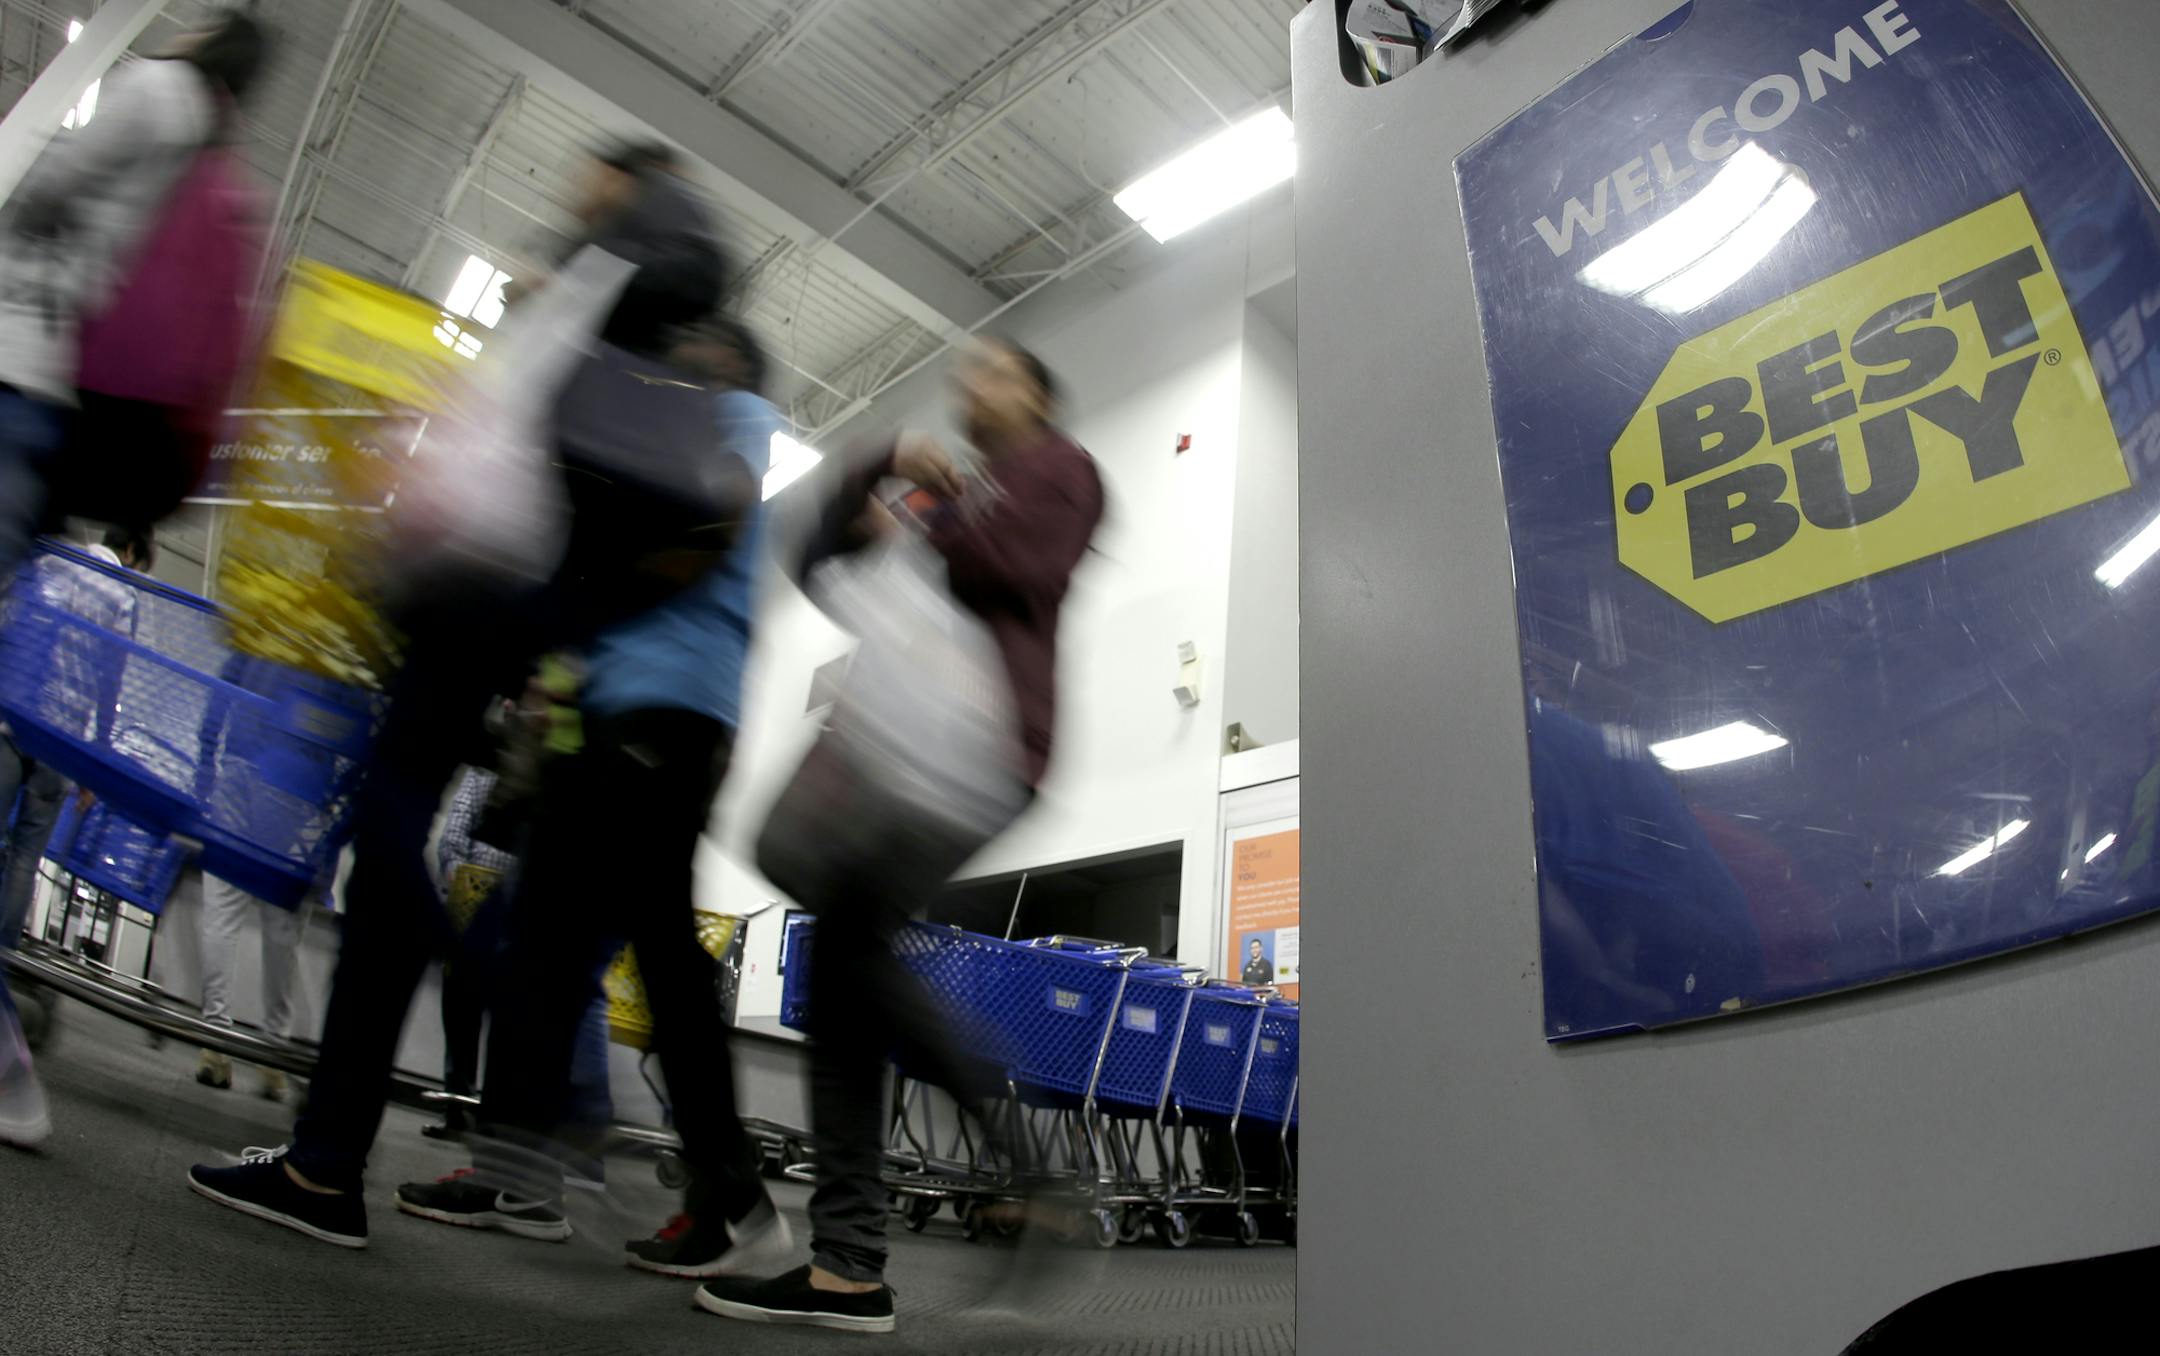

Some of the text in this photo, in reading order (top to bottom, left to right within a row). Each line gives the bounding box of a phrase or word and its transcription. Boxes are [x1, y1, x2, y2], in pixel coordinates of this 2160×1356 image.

[1532, 0, 1922, 258] WELCOME
[208, 440, 295, 463] ustomer
[1655, 244, 2043, 487] BEST
[1684, 351, 2041, 581] BUY
